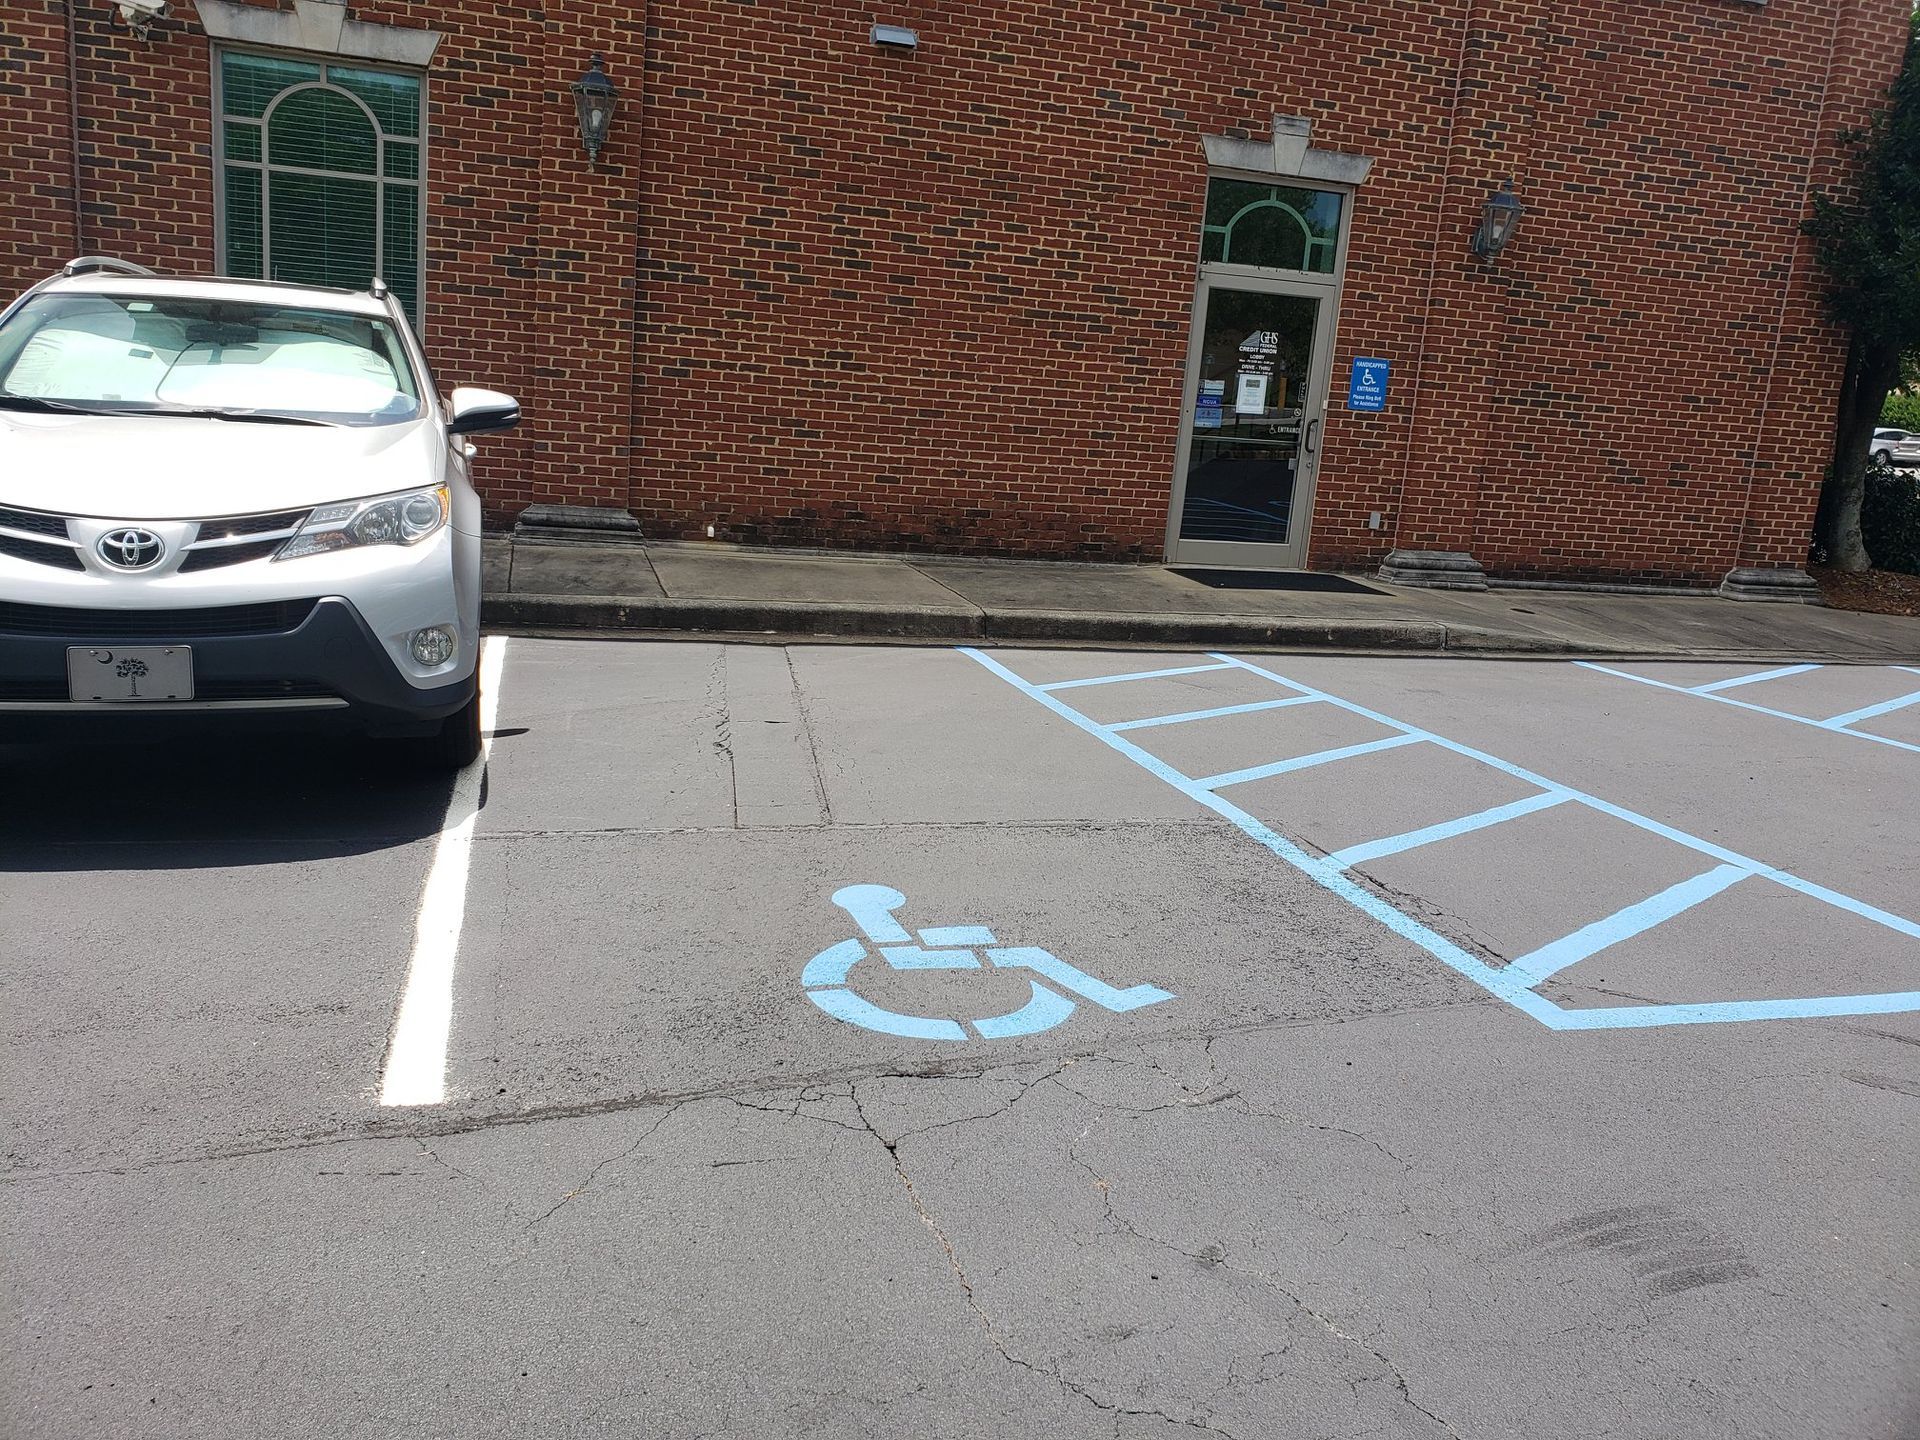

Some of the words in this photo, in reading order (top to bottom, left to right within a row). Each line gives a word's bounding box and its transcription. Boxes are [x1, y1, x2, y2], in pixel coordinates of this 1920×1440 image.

[1260, 331, 1279, 344] GHS
[1356, 361, 1387, 369] HANDICAPPED
[1356, 385, 1380, 393] ENTRANCE
